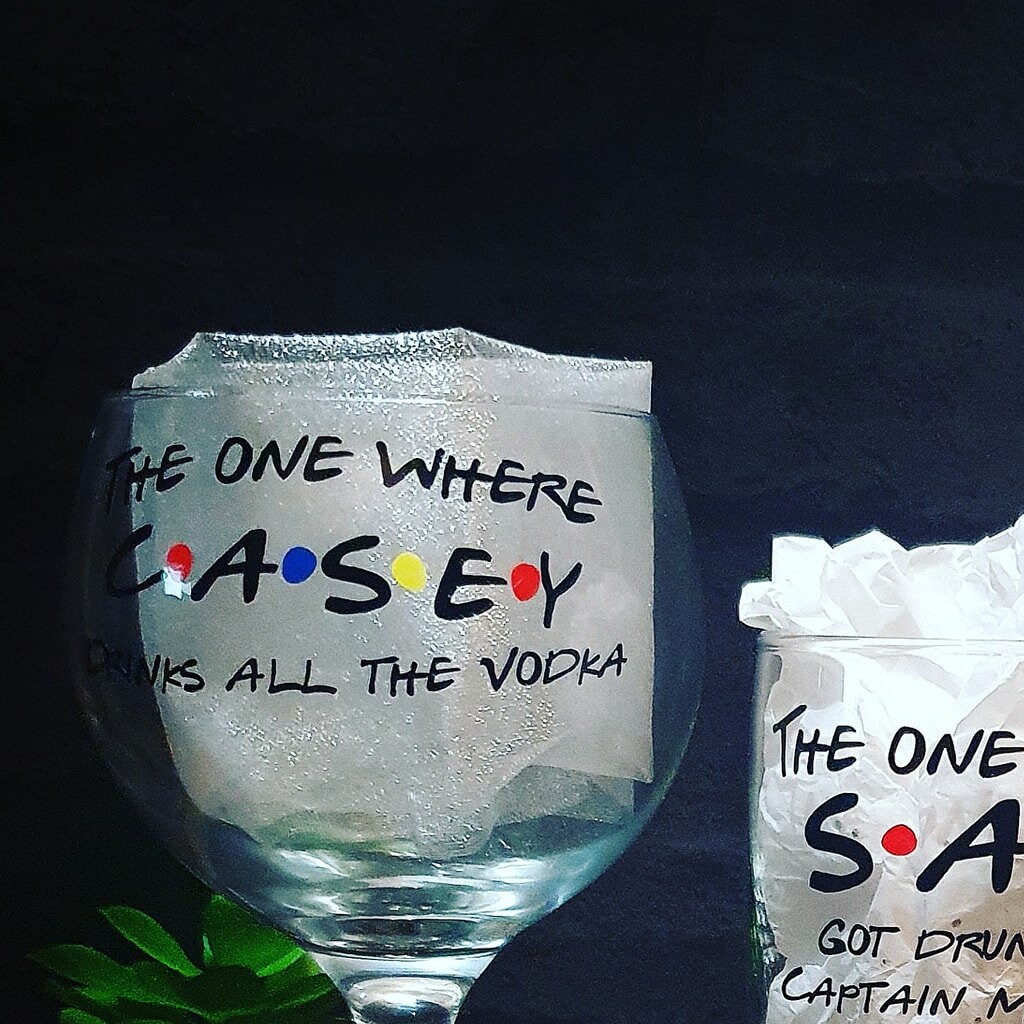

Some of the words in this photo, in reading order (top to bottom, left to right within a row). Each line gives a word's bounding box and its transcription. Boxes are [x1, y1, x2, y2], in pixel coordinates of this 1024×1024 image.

[106, 443, 193, 513] THE
[215, 435, 353, 485] ONE
[376, 440, 602, 524] WHERE
[225, 657, 337, 695] ALL
[361, 656, 461, 697] THE
[480, 643, 628, 693] VODKA
[773, 705, 865, 777] THE
[818, 918, 900, 958] GOT
[781, 966, 967, 1016] CAPTAIN
